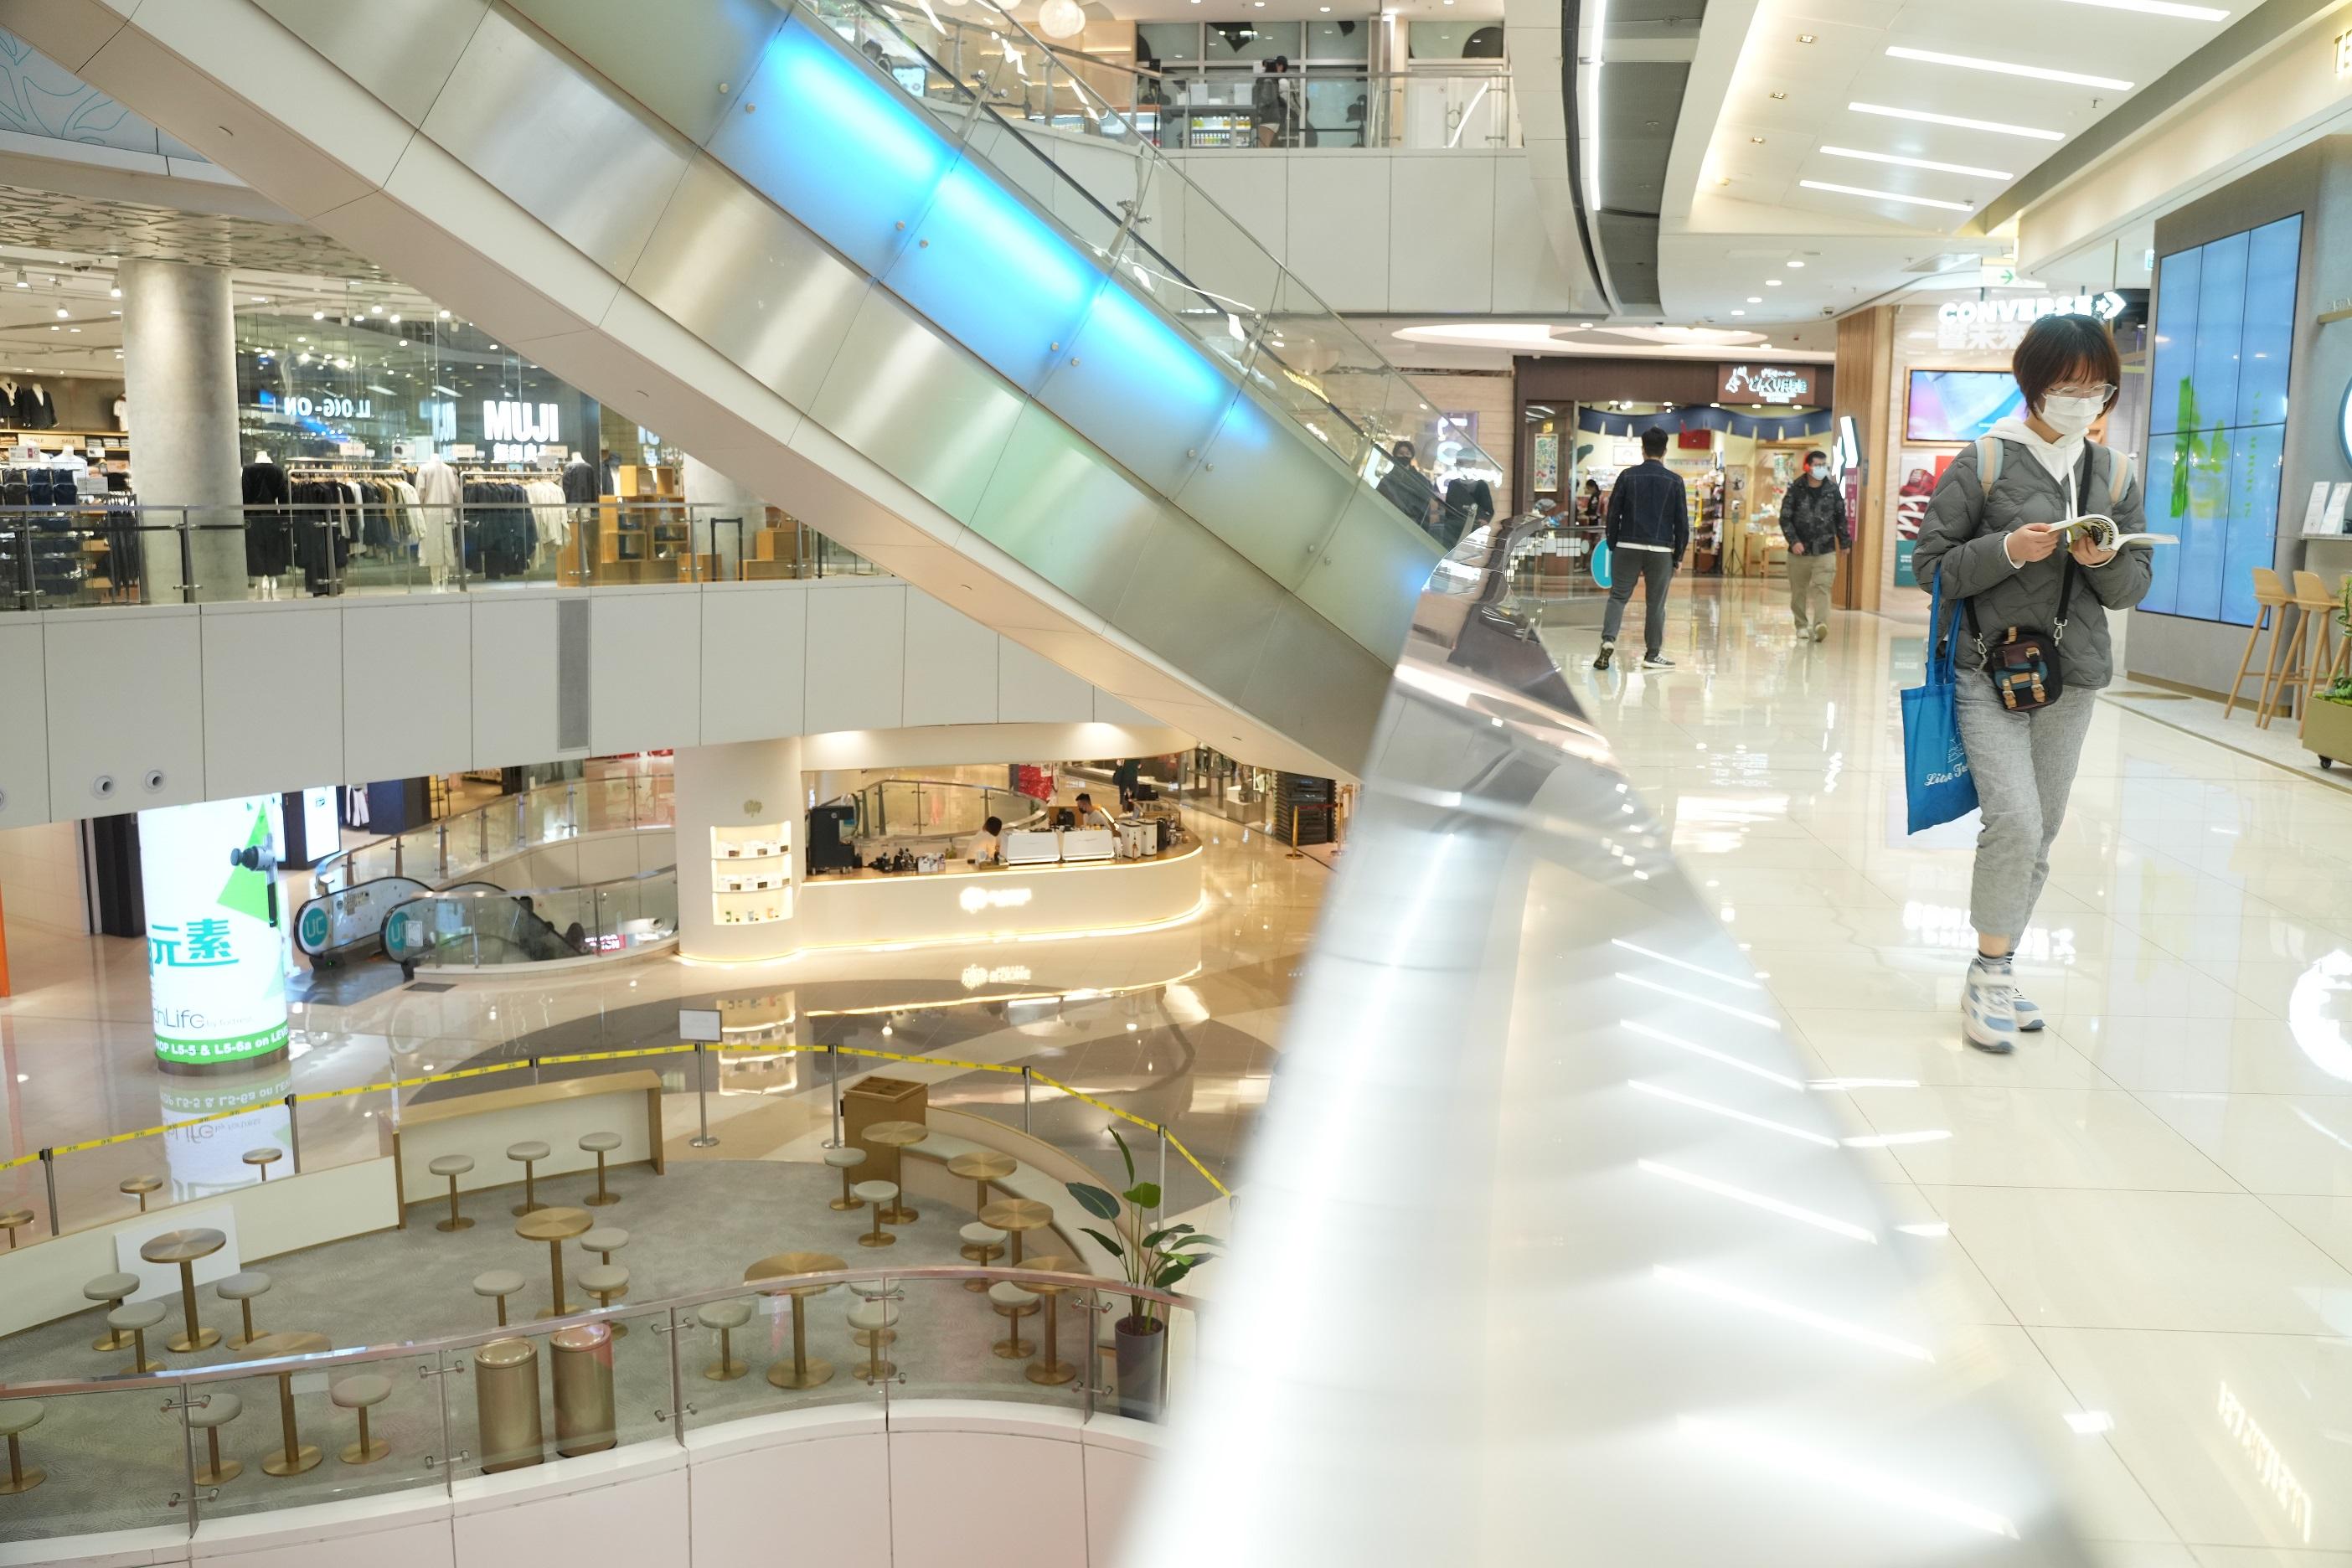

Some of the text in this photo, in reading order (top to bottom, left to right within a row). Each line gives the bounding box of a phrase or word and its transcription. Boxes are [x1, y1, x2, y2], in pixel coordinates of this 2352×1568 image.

[1937, 295, 2093, 325] CONVERSE
[483, 400, 560, 442] MUJI
[306, 916, 325, 939] UC
[147, 918, 240, 977] 元素
[156, 1037, 169, 1053] HOP
[171, 1043, 197, 1056] L5-5
[200, 1044, 211, 1056] &
[214, 1040, 252, 1055] L5-6a
[255, 1036, 270, 1049] on
